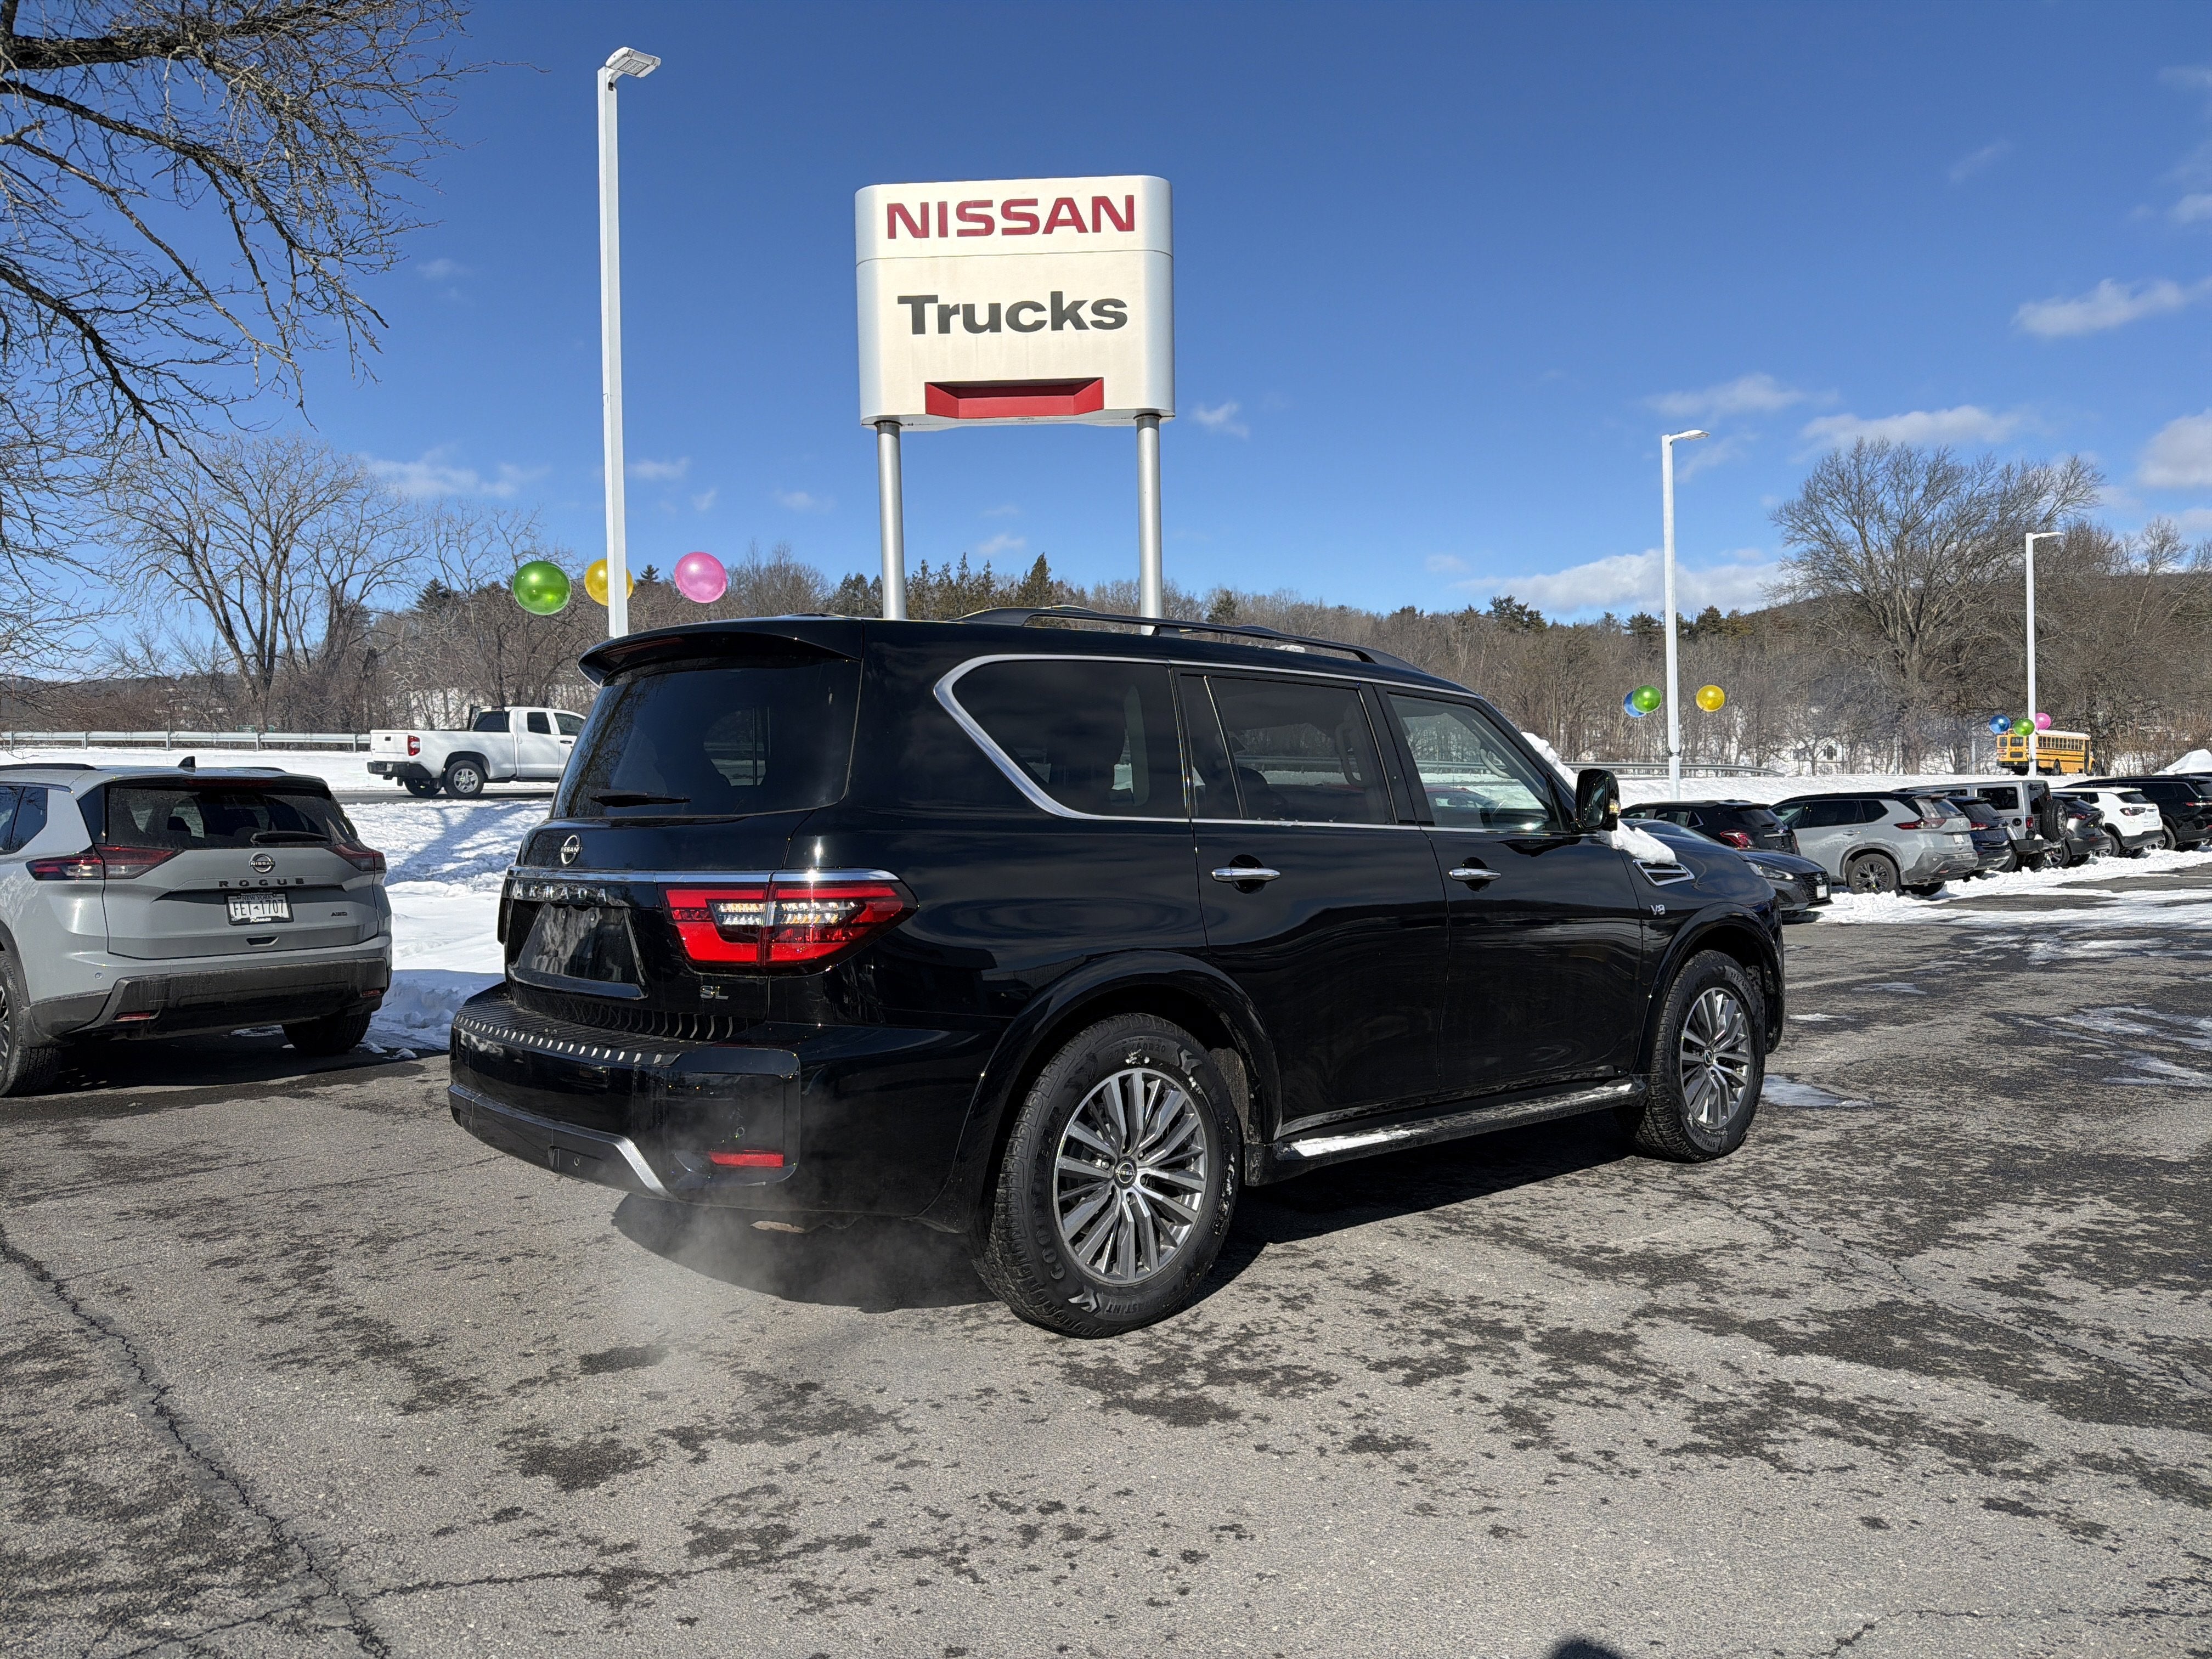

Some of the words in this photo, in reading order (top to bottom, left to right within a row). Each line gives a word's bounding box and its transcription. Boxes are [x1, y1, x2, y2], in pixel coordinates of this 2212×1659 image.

[887, 194, 1135, 240] NISSAN
[897, 291, 1128, 335] Trucks
[218, 878, 304, 888] ROGUE
[516, 882, 607, 902] ARMADA
[233, 901, 252, 916] FET
[259, 899, 284, 915] 1707
[1650, 904, 1666, 916] V8
[699, 985, 729, 1000] SL
